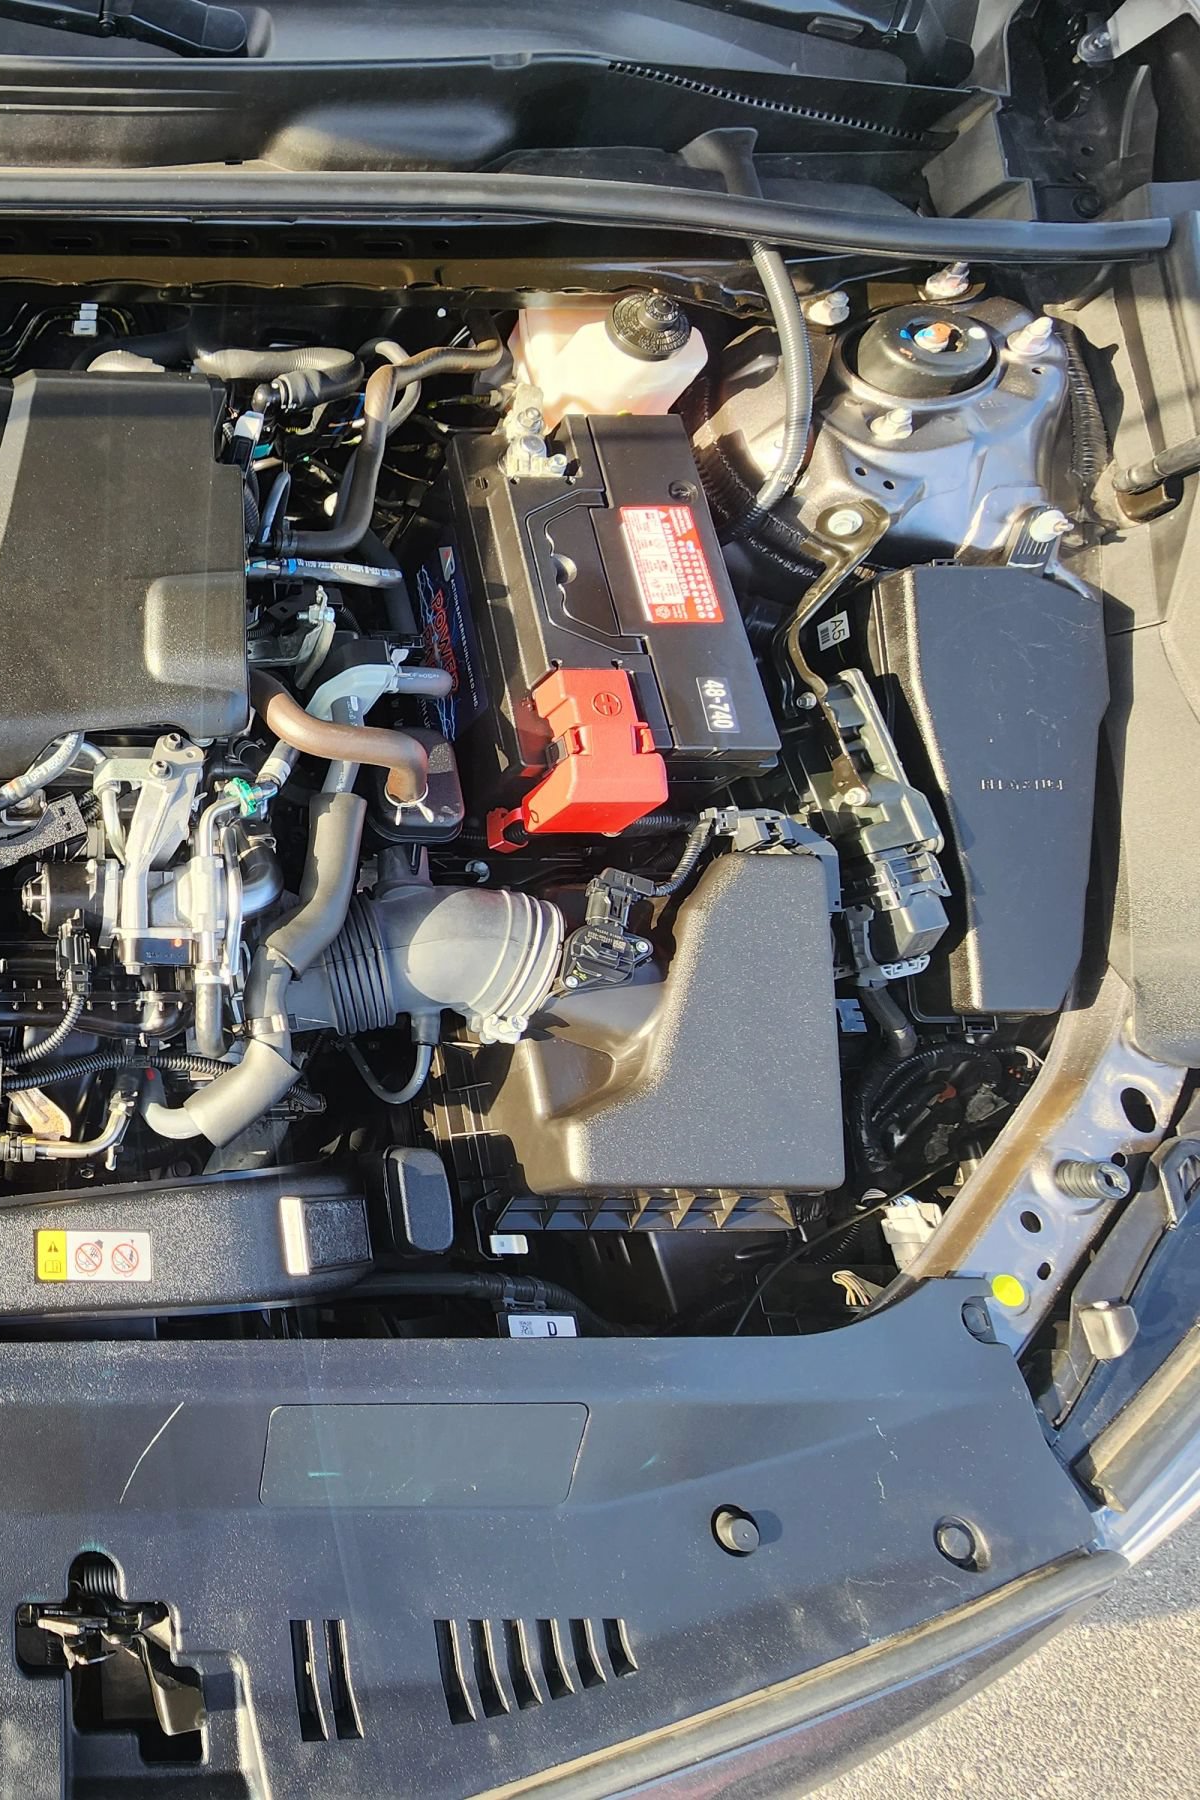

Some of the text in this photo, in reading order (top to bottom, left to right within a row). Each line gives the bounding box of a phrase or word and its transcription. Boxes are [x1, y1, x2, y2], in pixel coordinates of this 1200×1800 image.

[455, 606, 467, 647] BATTERIES
[830, 619, 846, 641] A5
[703, 678, 735, 729] 48-740
[546, 1321, 558, 1337] D
